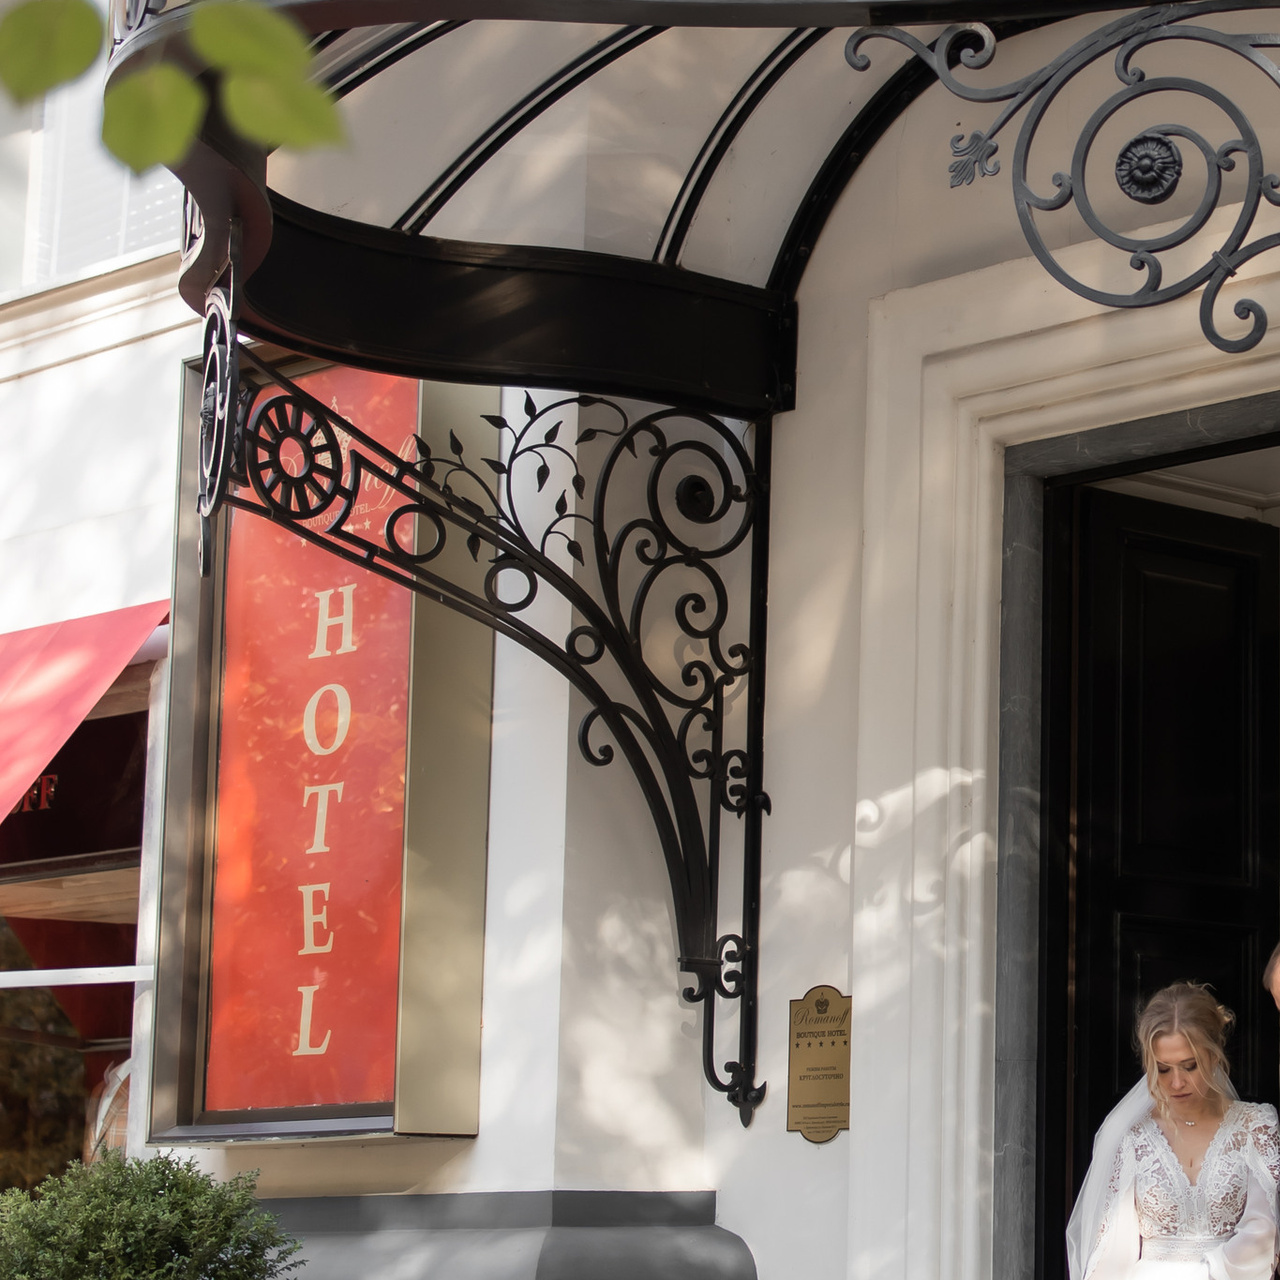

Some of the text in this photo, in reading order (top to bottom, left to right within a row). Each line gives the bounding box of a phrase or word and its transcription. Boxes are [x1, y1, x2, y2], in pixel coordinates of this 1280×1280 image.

[291, 582, 358, 1057] HOTEL
[793, 1007, 850, 1029] Romanoff
[796, 1029, 847, 1039] BOUTIQUE HOTEL
